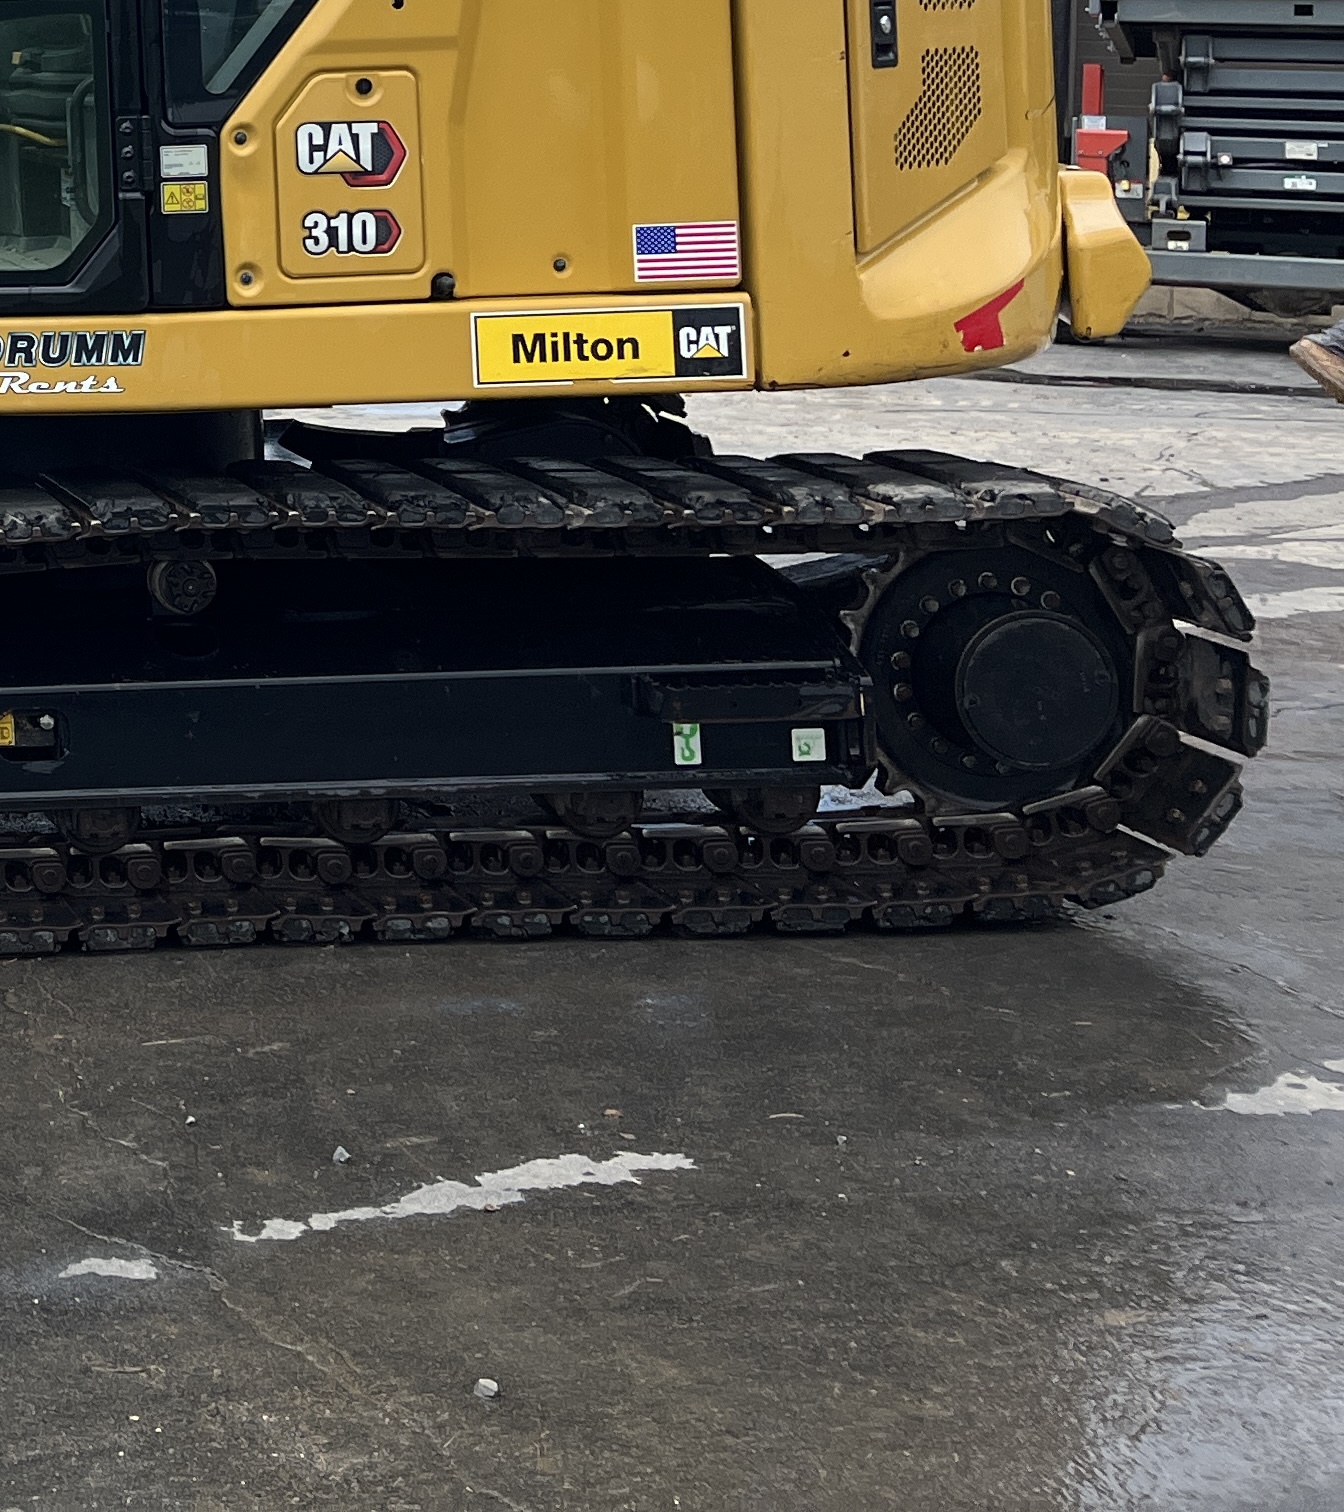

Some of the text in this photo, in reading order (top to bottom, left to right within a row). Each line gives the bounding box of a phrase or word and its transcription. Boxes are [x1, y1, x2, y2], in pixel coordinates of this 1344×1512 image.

[296, 122, 379, 173] CAT
[303, 211, 377, 254] 310
[511, 325, 732, 364] Milton CAT
